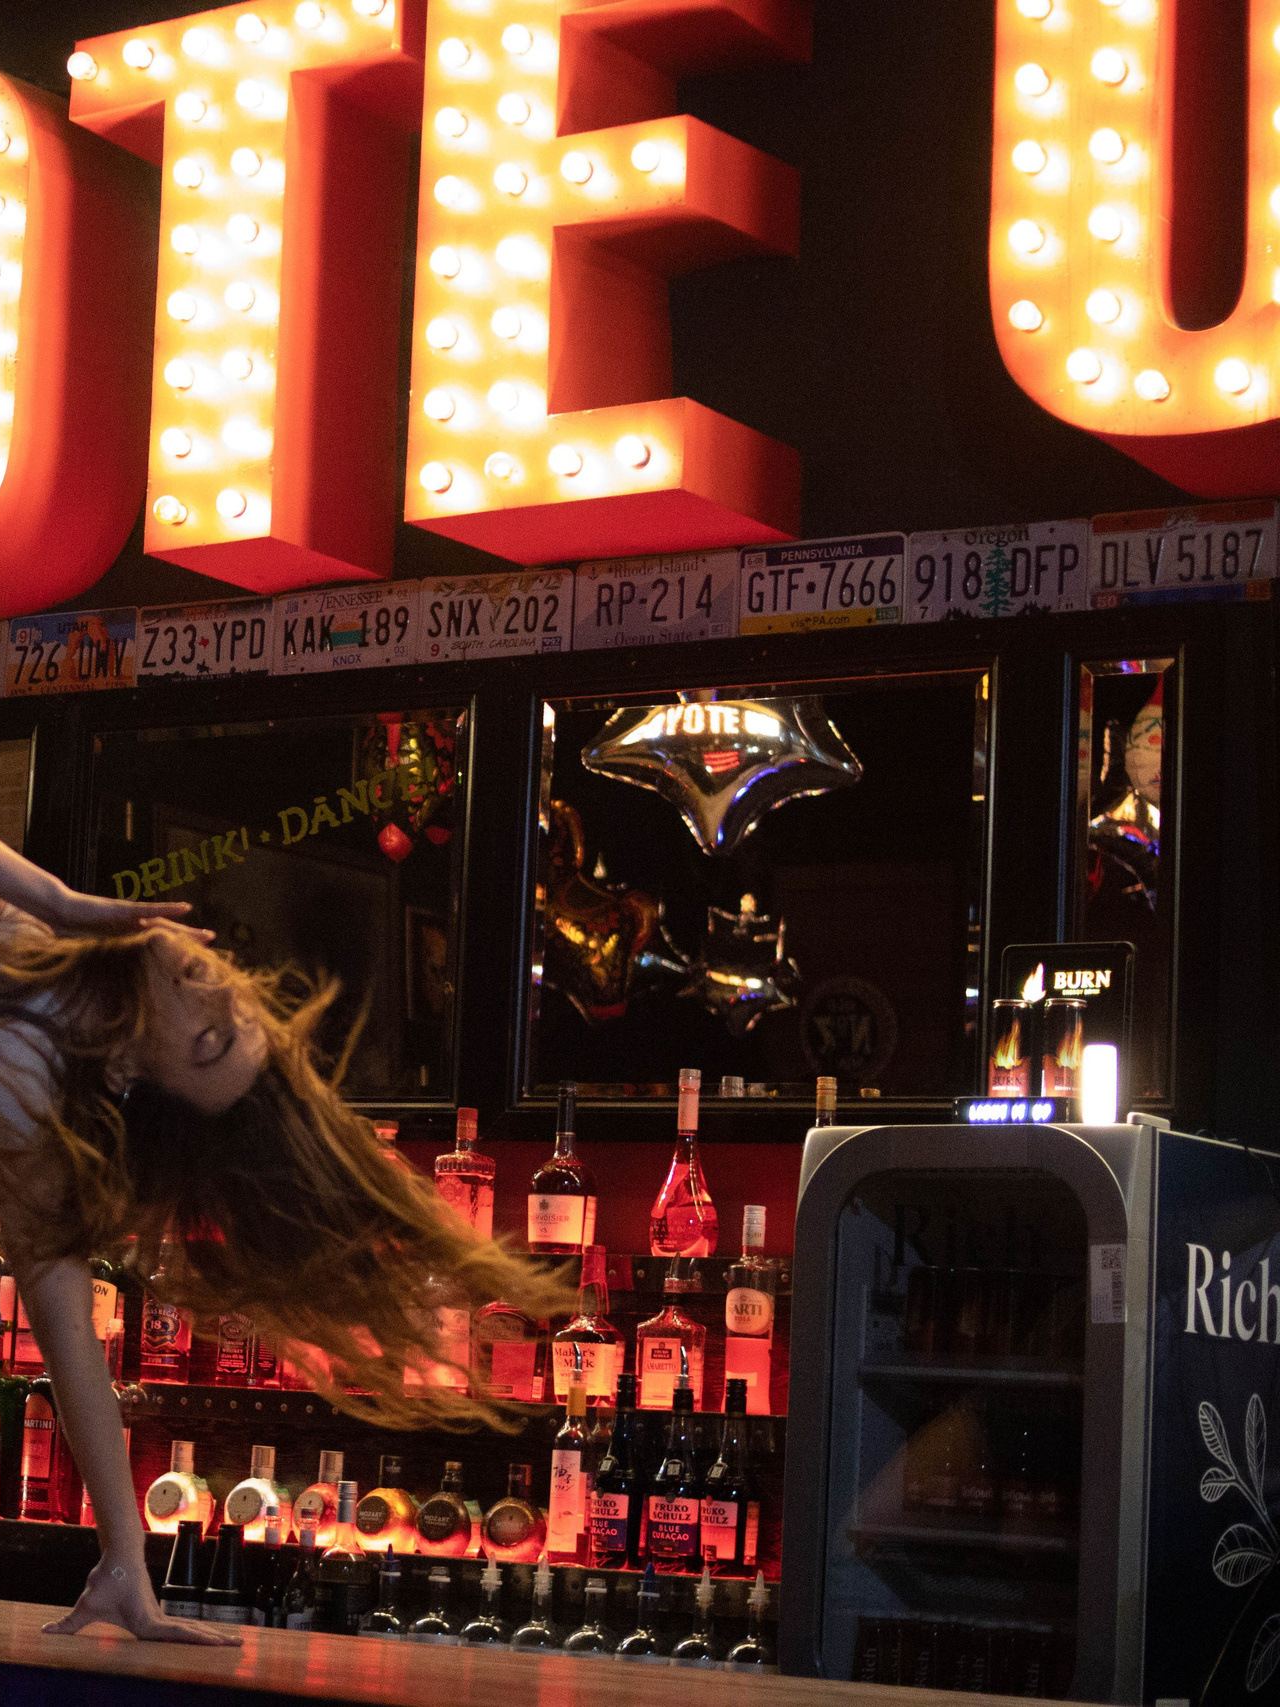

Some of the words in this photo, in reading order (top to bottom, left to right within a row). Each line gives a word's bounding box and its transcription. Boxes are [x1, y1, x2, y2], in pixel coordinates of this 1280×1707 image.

[963, 526, 1030, 547] Oregon
[781, 544, 863, 562] PENNSYLVANIA
[1100, 537, 1164, 589] DLV
[1178, 528, 1263, 583] 5187
[614, 563, 656, 579] Rhode
[659, 556, 699, 575] Island
[915, 551, 982, 603] 918
[1010, 543, 1079, 597] DFP
[747, 567, 804, 613] GTF
[820, 557, 896, 609] 7666
[315, 590, 382, 613] TENNESSEE
[596, 574, 712, 627] RP-214
[428, 598, 482, 638] SNX
[504, 595, 559, 634] 202
[18, 630, 28, 643] 9
[57, 621, 89, 634] UTAH
[283, 614, 335, 656] KAK
[358, 606, 409, 648] 189
[142, 624, 197, 669] Z33
[213, 618, 266, 662] YPD
[451, 640, 483, 650] SOUTH
[488, 637, 538, 649] CAROLINA
[614, 632, 657, 646] Ocean
[660, 629, 693, 643] State
[430, 644, 440, 657] 9
[14, 643, 61, 685] 726
[332, 654, 362, 667] KNOX
[113, 826, 249, 902] DRINK!
[1053, 970, 1112, 989] BURN
[1183, 1242, 1280, 1345] Rich
[151, 1320, 162, 1329] 18
[555, 1348, 595, 1358] Makr's
[24, 1418, 53, 1430] MARTINI
[652, 1511, 691, 1521] SCHULZ
[654, 1502, 689, 1512] FRUKO
[423, 1515, 450, 1523] MOZART
[652, 1531, 690, 1542] CURAÇAO
[658, 1524, 680, 1533] BLUE
